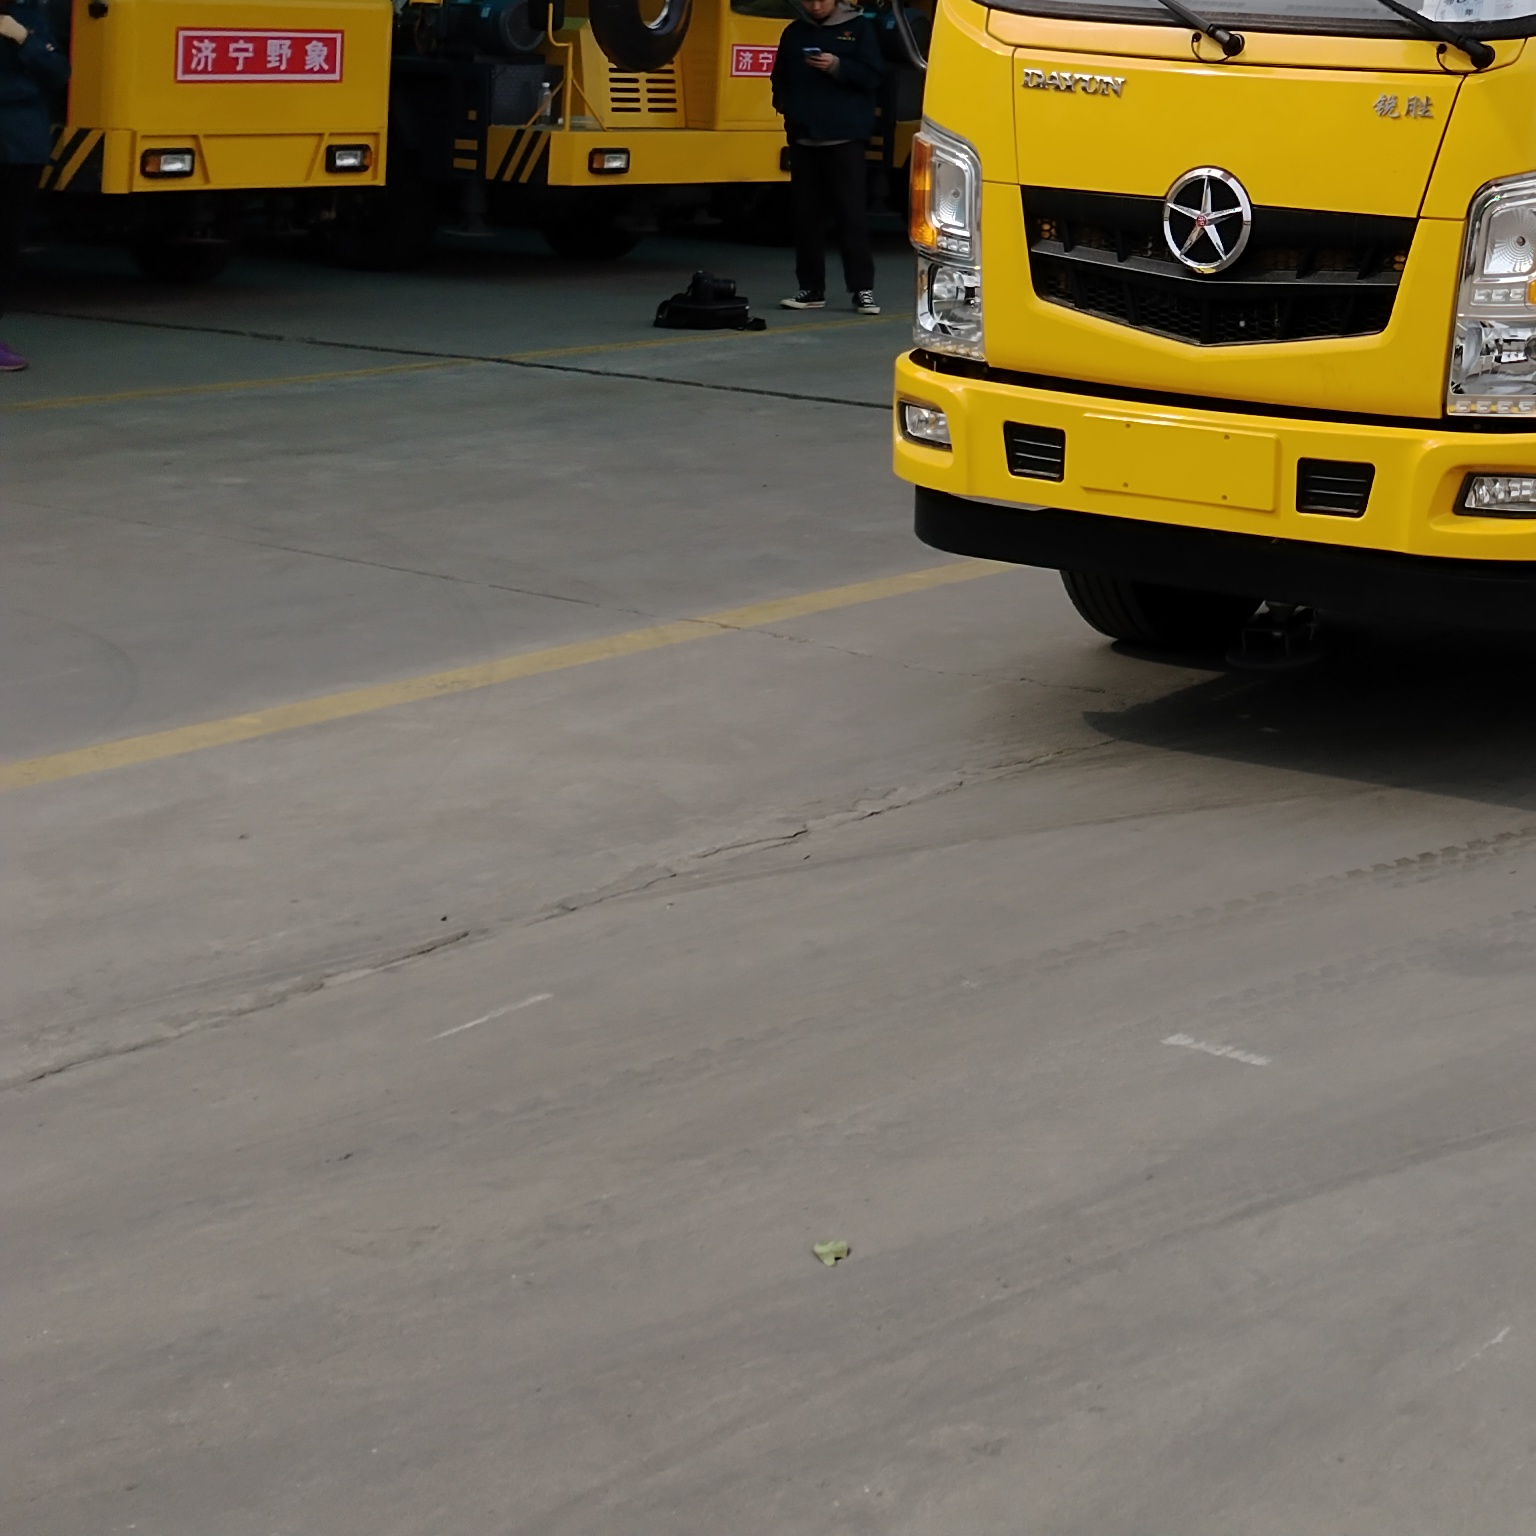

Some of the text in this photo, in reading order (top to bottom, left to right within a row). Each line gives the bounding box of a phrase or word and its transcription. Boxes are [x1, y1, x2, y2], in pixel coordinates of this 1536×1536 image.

[190, 39, 331, 72] 济宁野象
[738, 51, 773, 71] 济宁
[1022, 68, 1125, 96] DAYUN
